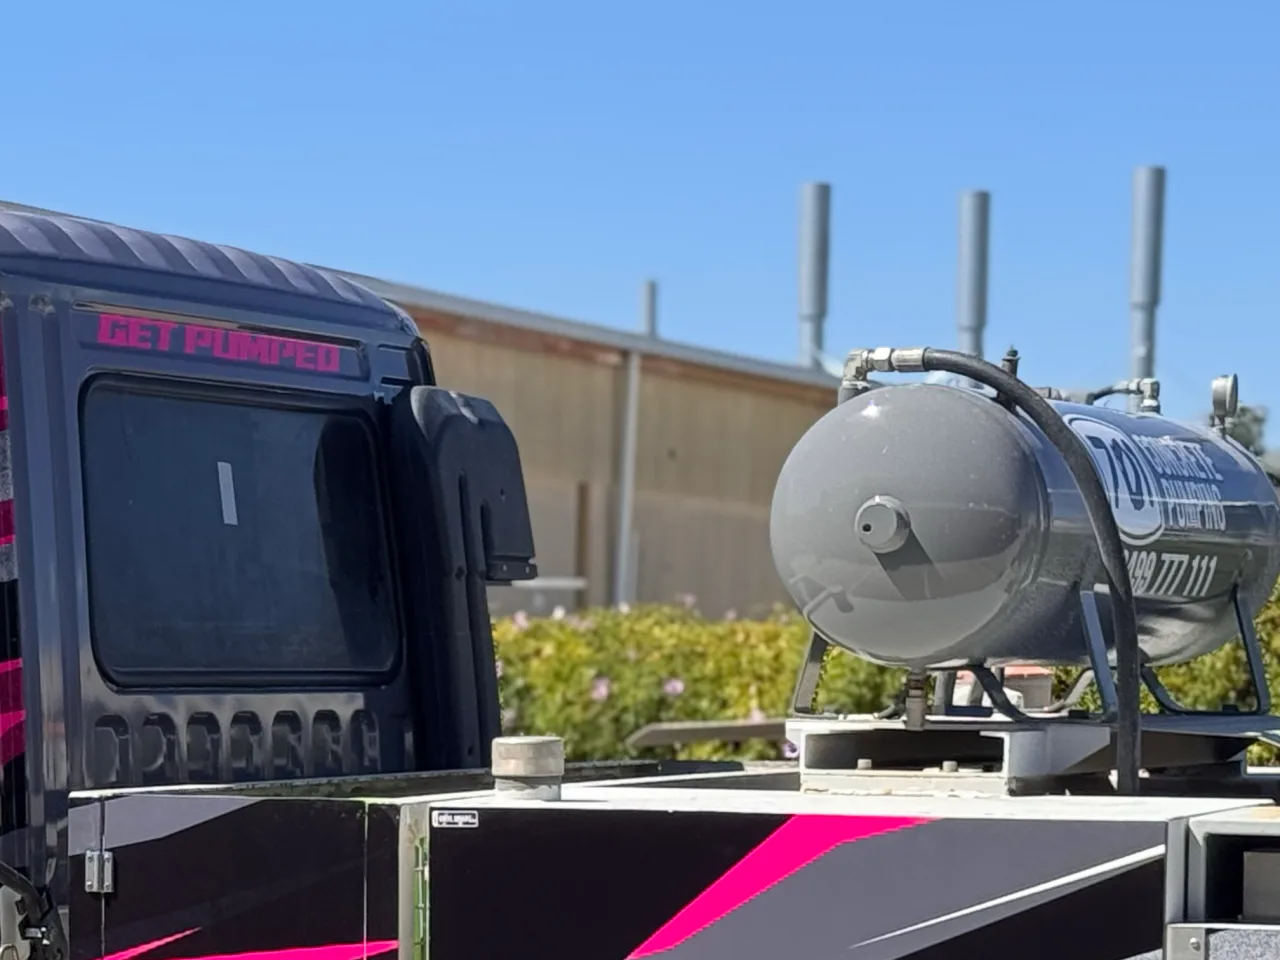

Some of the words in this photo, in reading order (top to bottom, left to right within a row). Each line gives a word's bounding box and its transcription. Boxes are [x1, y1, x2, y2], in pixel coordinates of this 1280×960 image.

[97, 313, 177, 351] GET
[184, 324, 341, 373] PUMPED
[1131, 434, 1224, 481] CONCRETE
[1160, 478, 1227, 531] PUMPING
[1124, 549, 1157, 596] 499
[1149, 553, 1189, 596] 777
[1183, 555, 1218, 597] 111
